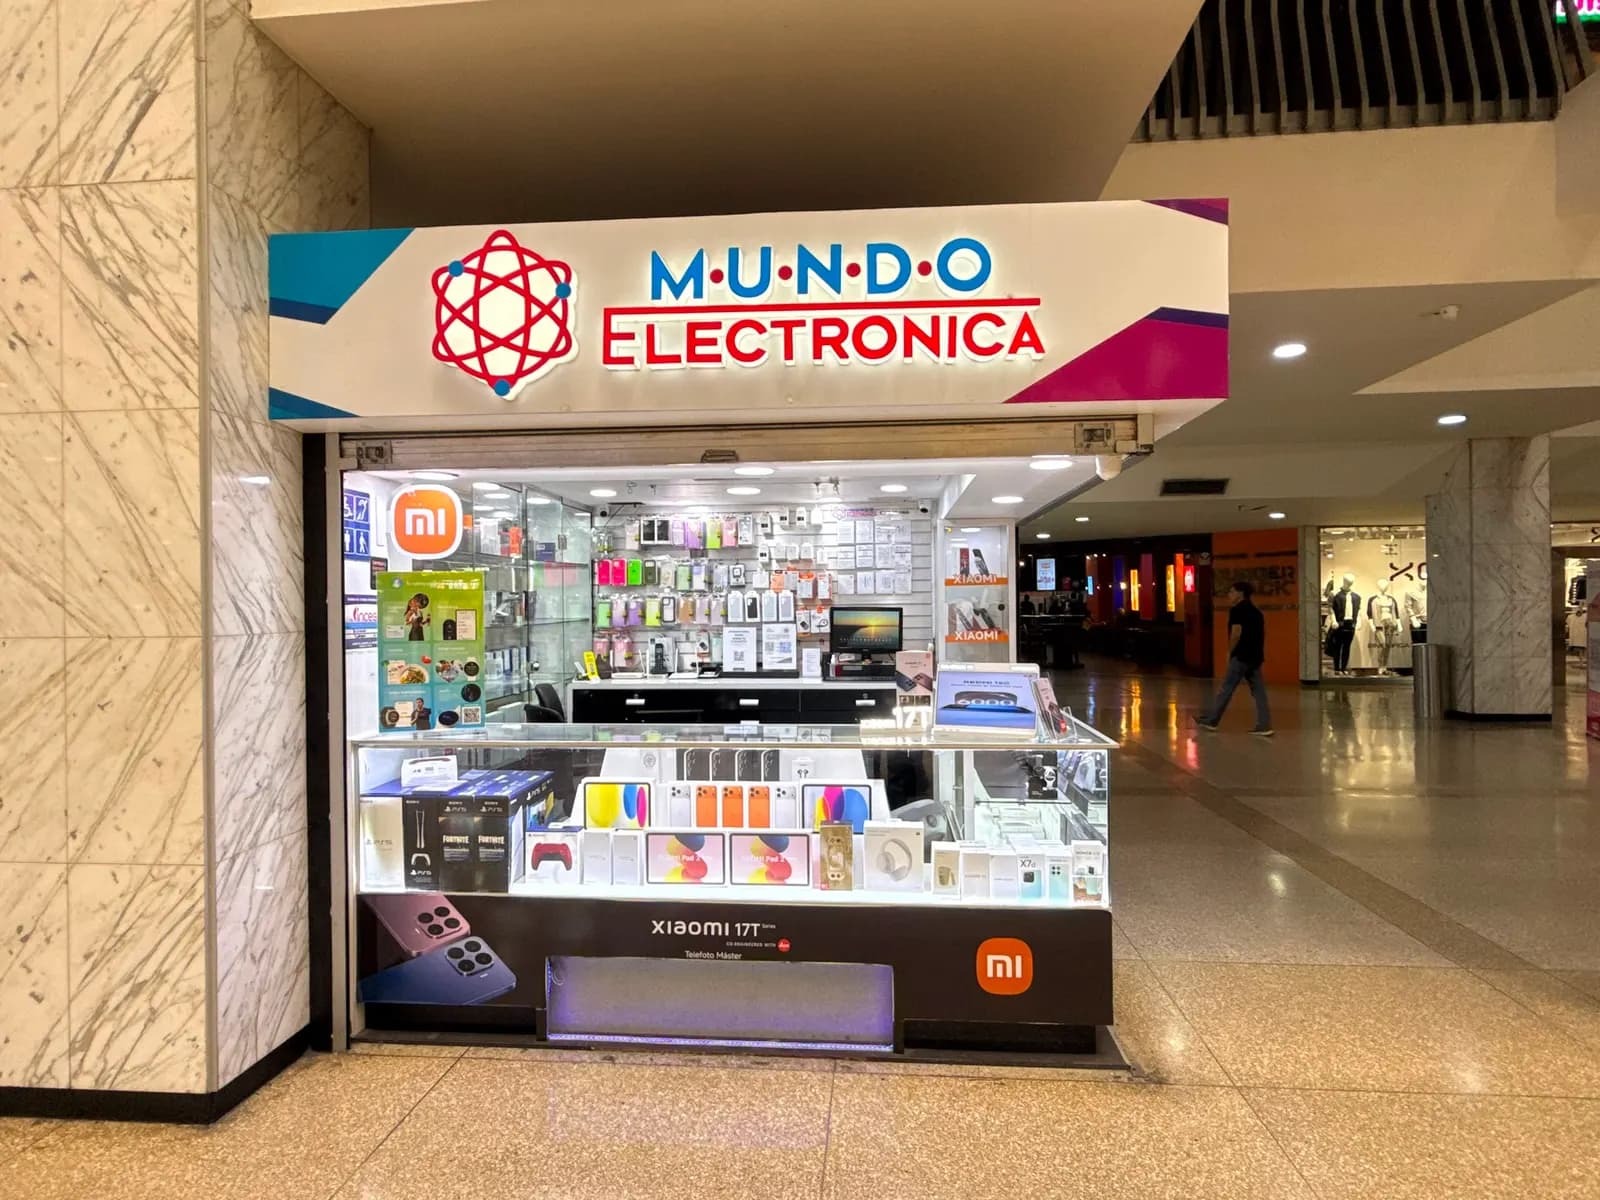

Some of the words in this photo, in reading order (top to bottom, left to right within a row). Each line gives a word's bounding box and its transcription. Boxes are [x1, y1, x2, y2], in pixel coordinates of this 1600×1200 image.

[603, 298, 1046, 365] ELECTRONICA
[953, 573, 998, 585] XIAOMI
[955, 630, 998, 641] XIAOMI
[734, 923, 761, 936] 17T
[685, 950, 715, 959] Telefoto
[716, 951, 742, 960] Máster
